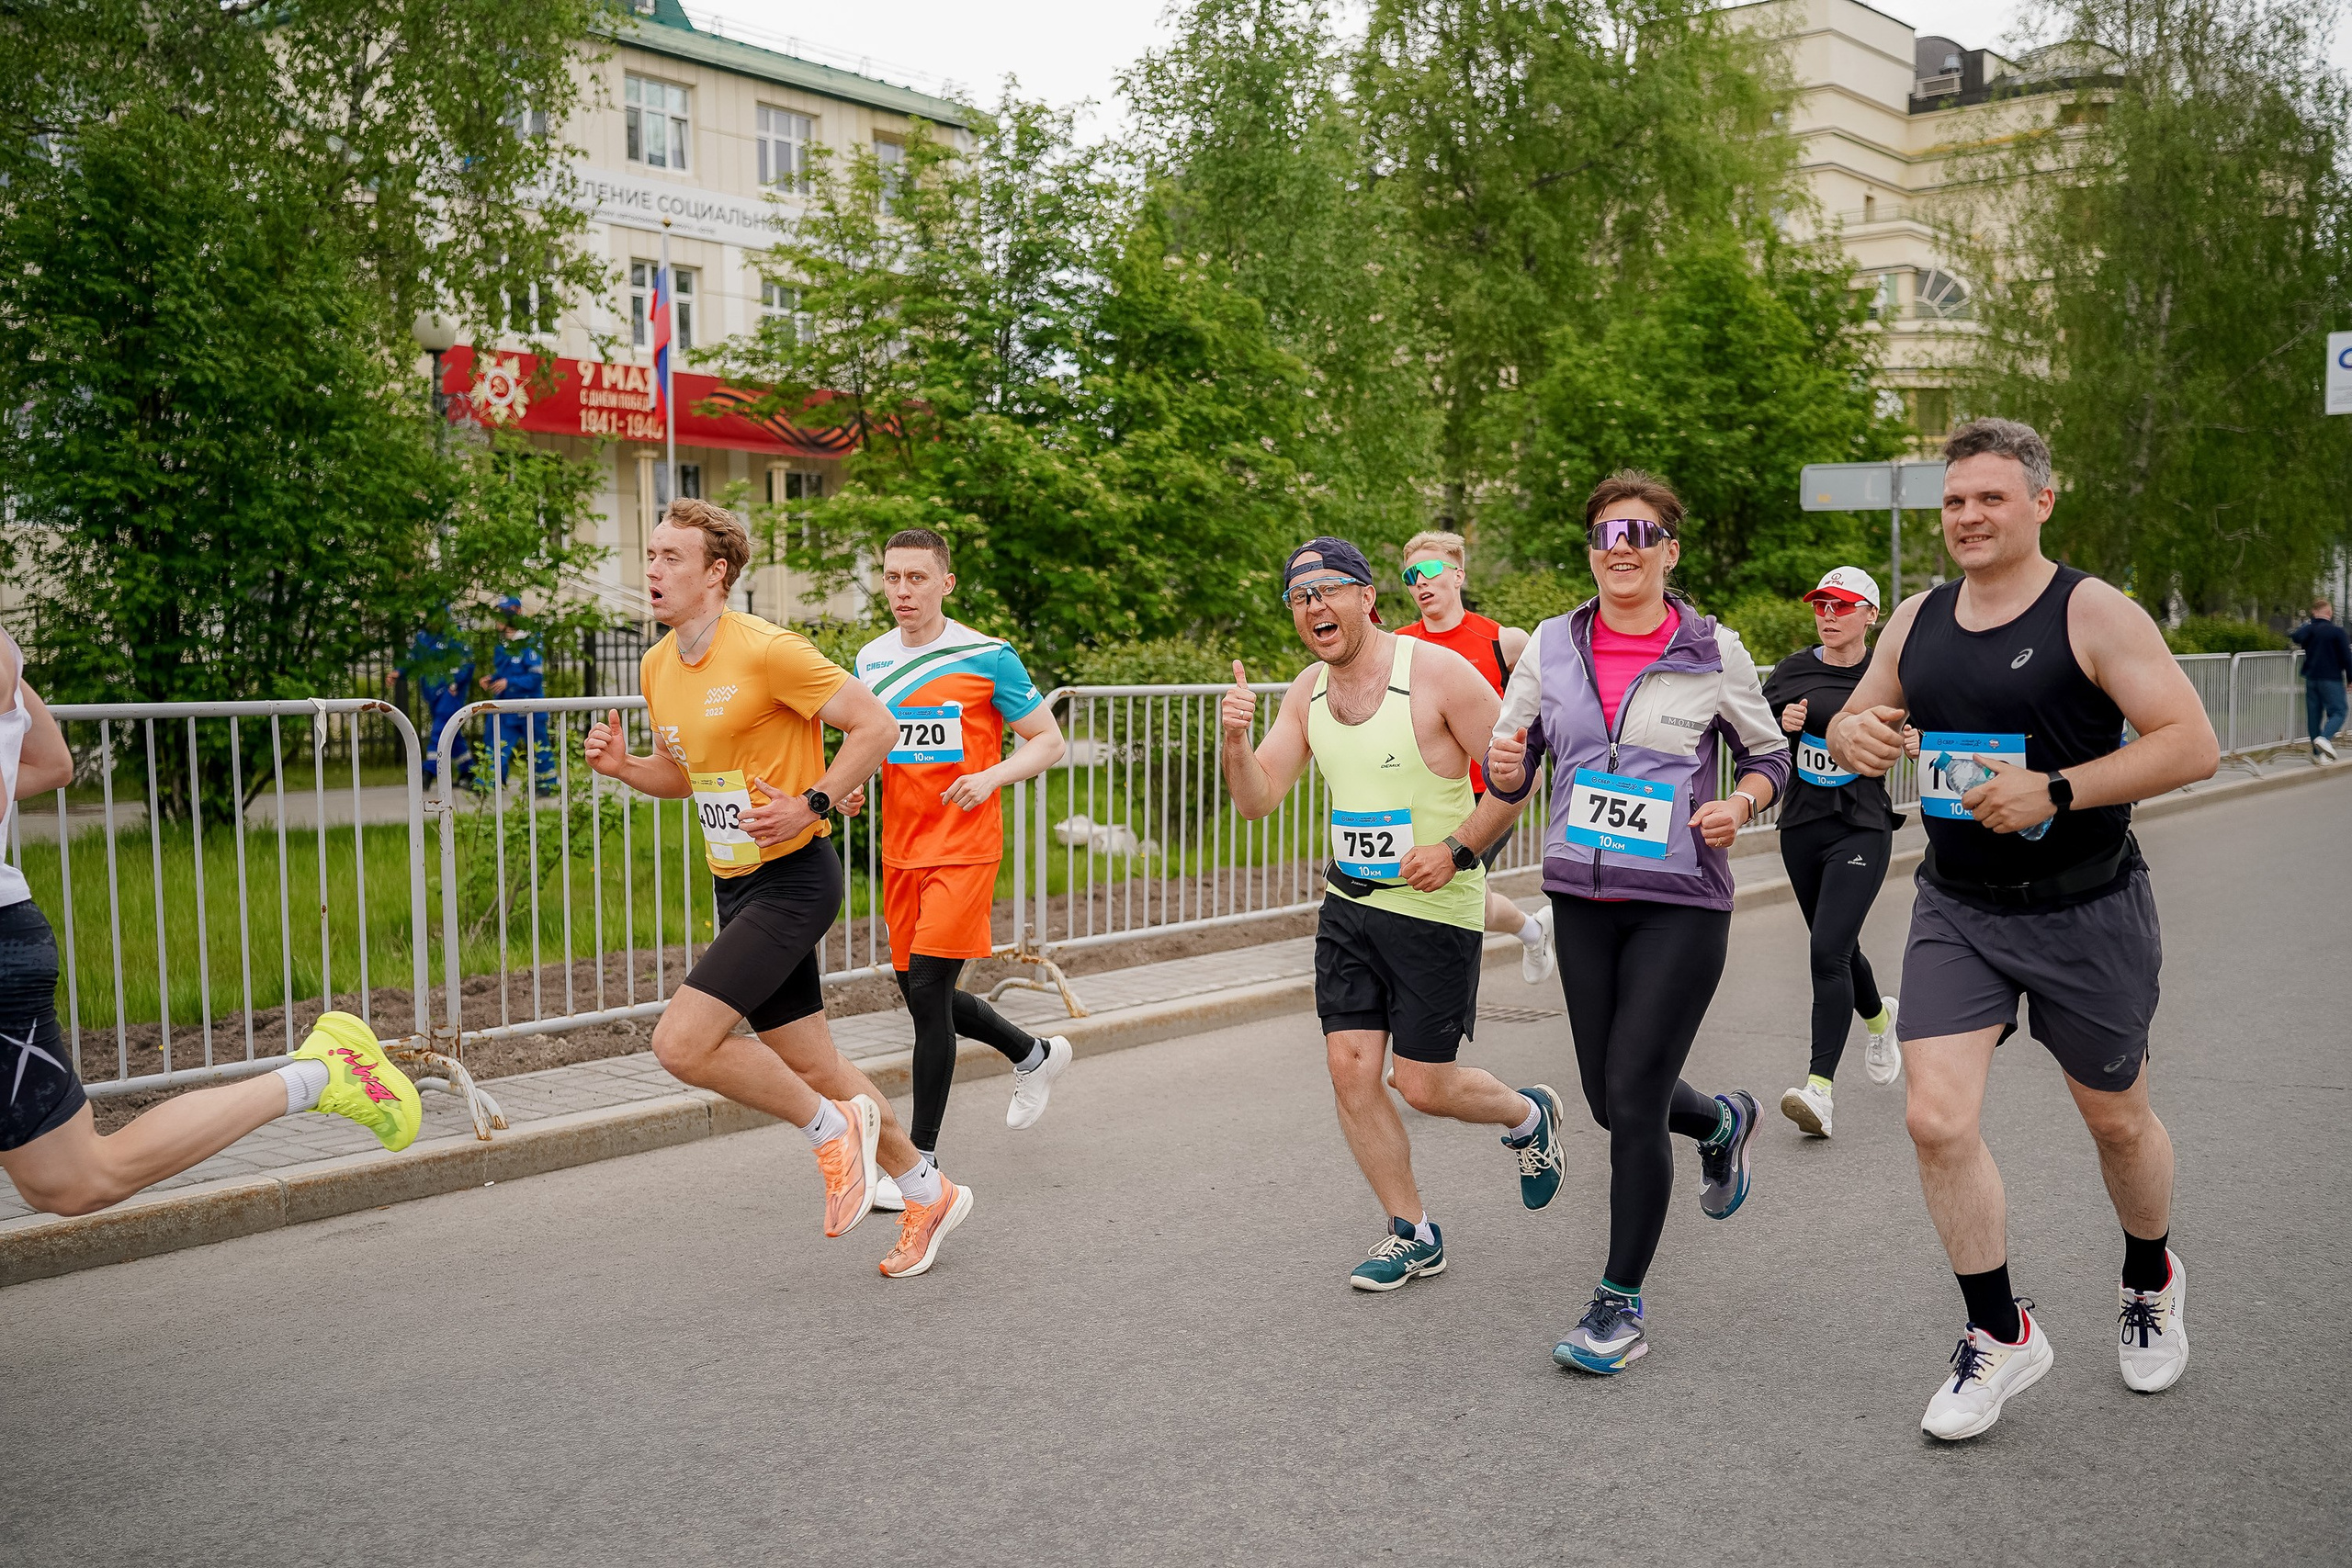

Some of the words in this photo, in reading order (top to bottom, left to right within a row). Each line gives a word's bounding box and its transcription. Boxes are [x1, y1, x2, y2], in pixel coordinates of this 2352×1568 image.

[657, 194, 782, 233] СОЦИАЛЬНО
[576, 360, 596, 387] 9
[579, 388, 589, 406] С
[865, 660, 895, 671] СИБУР
[705, 706, 724, 717] 2022
[899, 723, 945, 747] 720
[913, 752, 924, 762] 10
[1817, 776, 1826, 784] 10
[1589, 794, 1648, 833] 754
[1950, 802, 1963, 816] 10
[1343, 831, 1396, 858] 752
[1599, 835, 1612, 848] 10
[1358, 866, 1370, 876] 10
